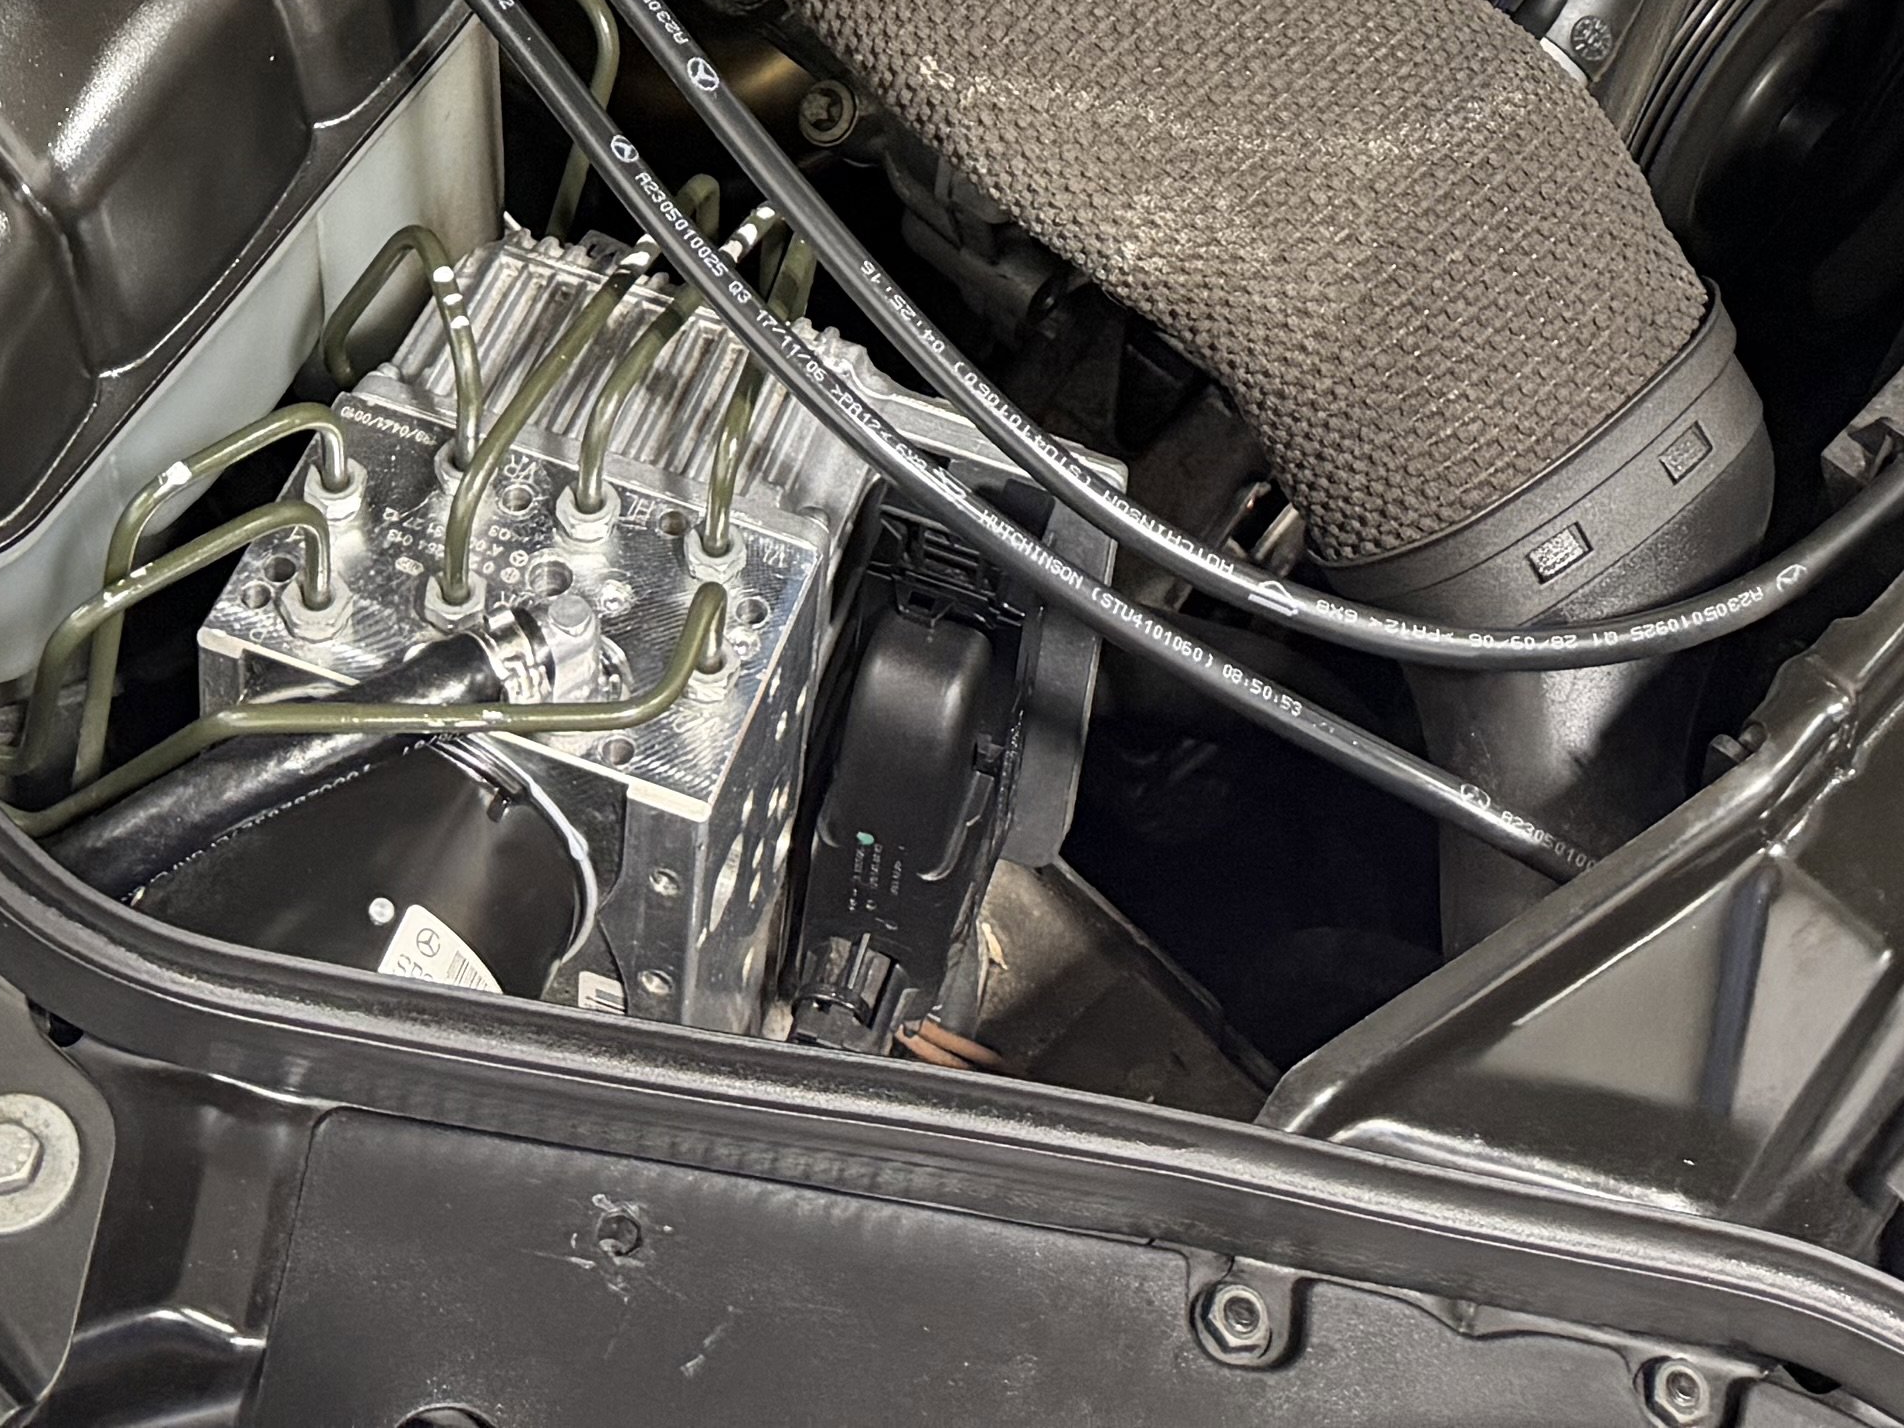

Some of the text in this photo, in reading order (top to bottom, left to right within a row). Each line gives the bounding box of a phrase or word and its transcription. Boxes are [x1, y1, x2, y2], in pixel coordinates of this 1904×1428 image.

[633, 169, 729, 279] A2305010025
[725, 277, 754, 306] Q3
[752, 306, 829, 383] 17/11/06
[976, 508, 1084, 589] HUTCHINSON
[1088, 585, 1214, 669] (STU4101060)
[1218, 663, 1304, 716] 08:50:53
[503, 451, 540, 486] VR
[1627, 583, 1764, 642] A2305010925
[1591, 631, 1618, 646] Q1
